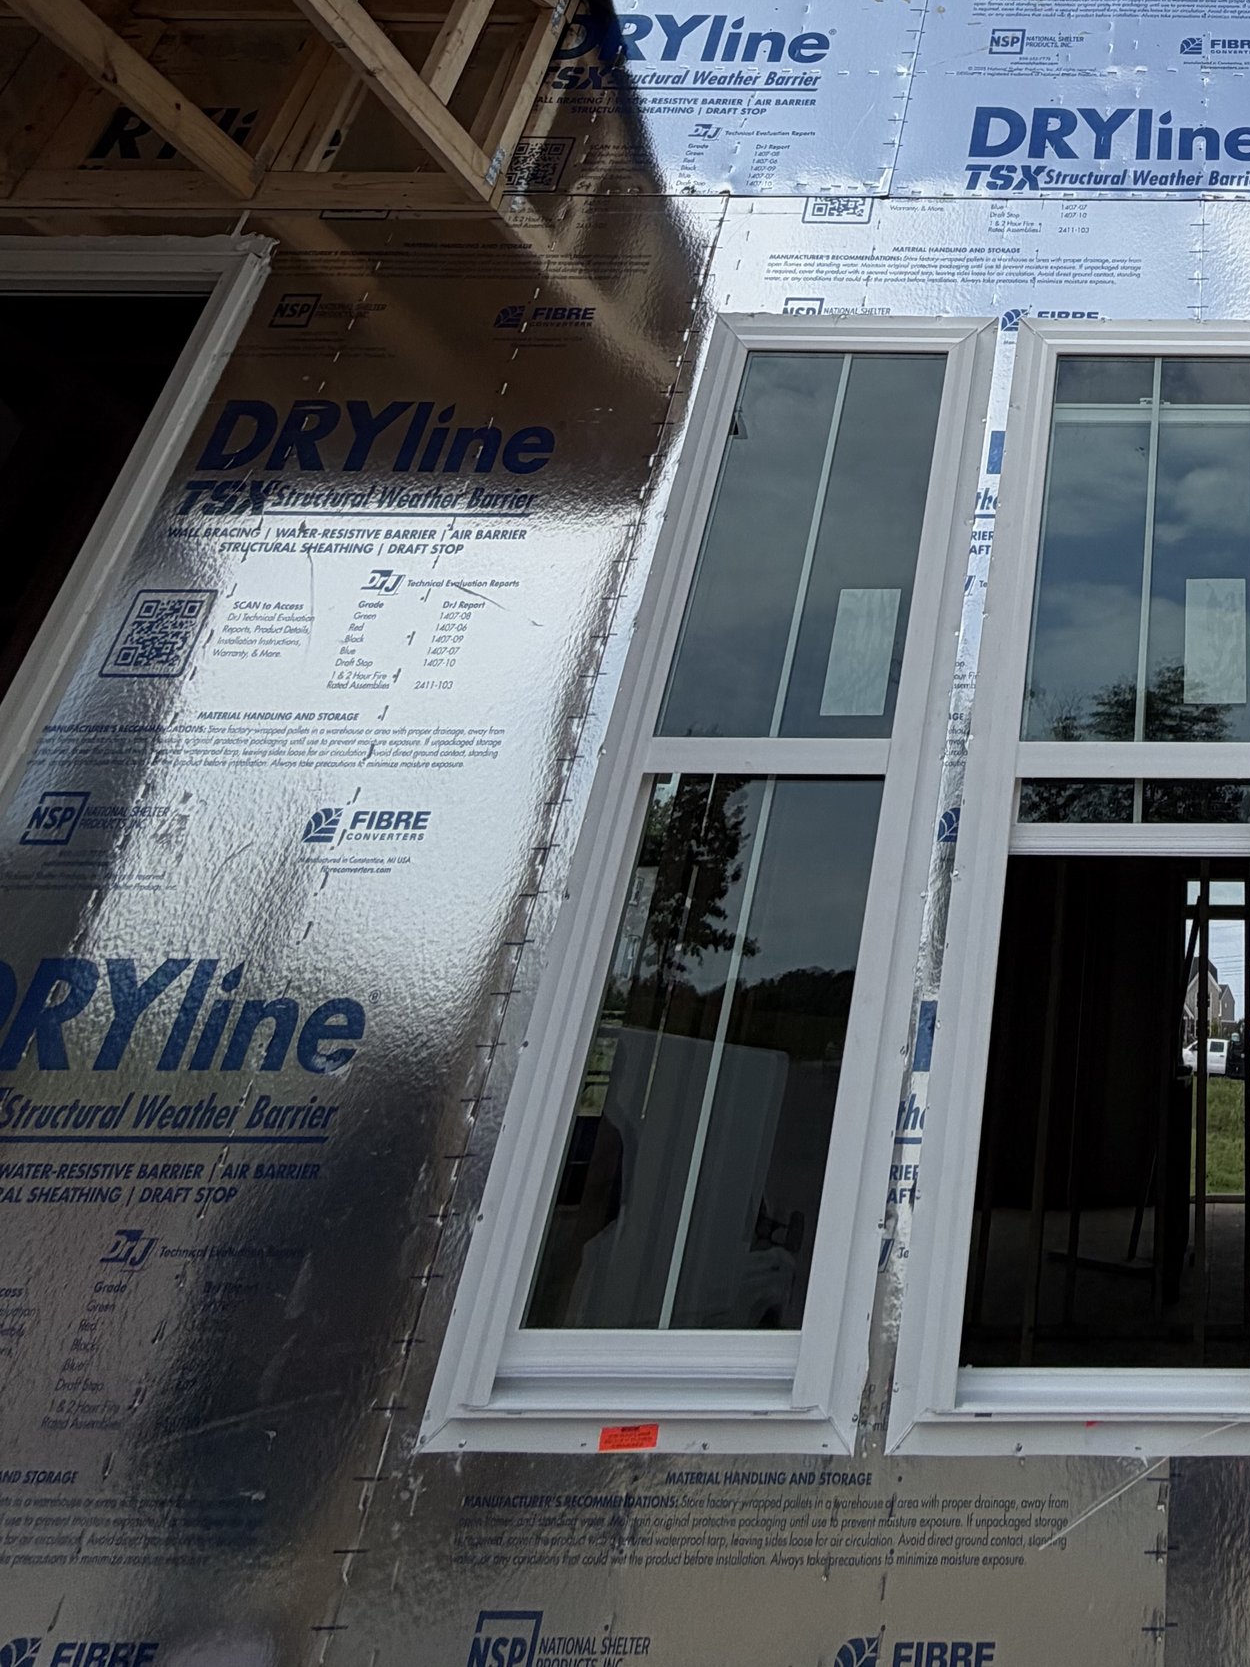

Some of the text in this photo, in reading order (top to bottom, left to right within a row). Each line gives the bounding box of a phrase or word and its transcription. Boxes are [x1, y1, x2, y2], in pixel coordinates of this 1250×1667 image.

[991, 35, 1021, 48] NSP
[693, 70, 822, 87] Weather Barrier
[964, 164, 1048, 191] TSX
[1044, 168, 1127, 186] Structural
[1132, 169, 1203, 187] Weather
[532, 307, 596, 321] FIBRE
[194, 399, 557, 475] DRYline
[181, 480, 539, 517] TSX Structural Weather Barrier
[275, 528, 382, 540] WATER-RESISTIVE
[383, 528, 437, 540] BARRIER
[449, 528, 473, 540] AIR
[475, 528, 527, 540] BARRIER
[218, 542, 464, 554] STRUCTURAL SHEATHING DRAFT STOP
[232, 601, 261, 611] SCAN
[262, 601, 272, 611] to
[273, 601, 305, 611] Access
[358, 600, 385, 609] Grade
[459, 601, 486, 610] Report
[435, 623, 468, 632] 1407-06
[431, 635, 464, 644] 1407-09
[423, 659, 457, 668] 1407-10
[414, 681, 454, 690] 2411-103
[350, 811, 432, 831] FIBRE
[345, 833, 425, 842] CONVERTERS
[1, 1092, 339, 1131] Structural Weather Barrier
[665, 1472, 872, 1485] MATERIAL HANDLING AND STORAGE
[921, 1496, 1019, 1513] with proper drainage,
[653, 1515, 1068, 1531] original protective unpackaged storage
[655, 1534, 706, 1549] waterproof
[645, 1553, 938, 1568] product Always minimize
[539, 1636, 996, 1667] NATIONAL SHELTER FIBRE
